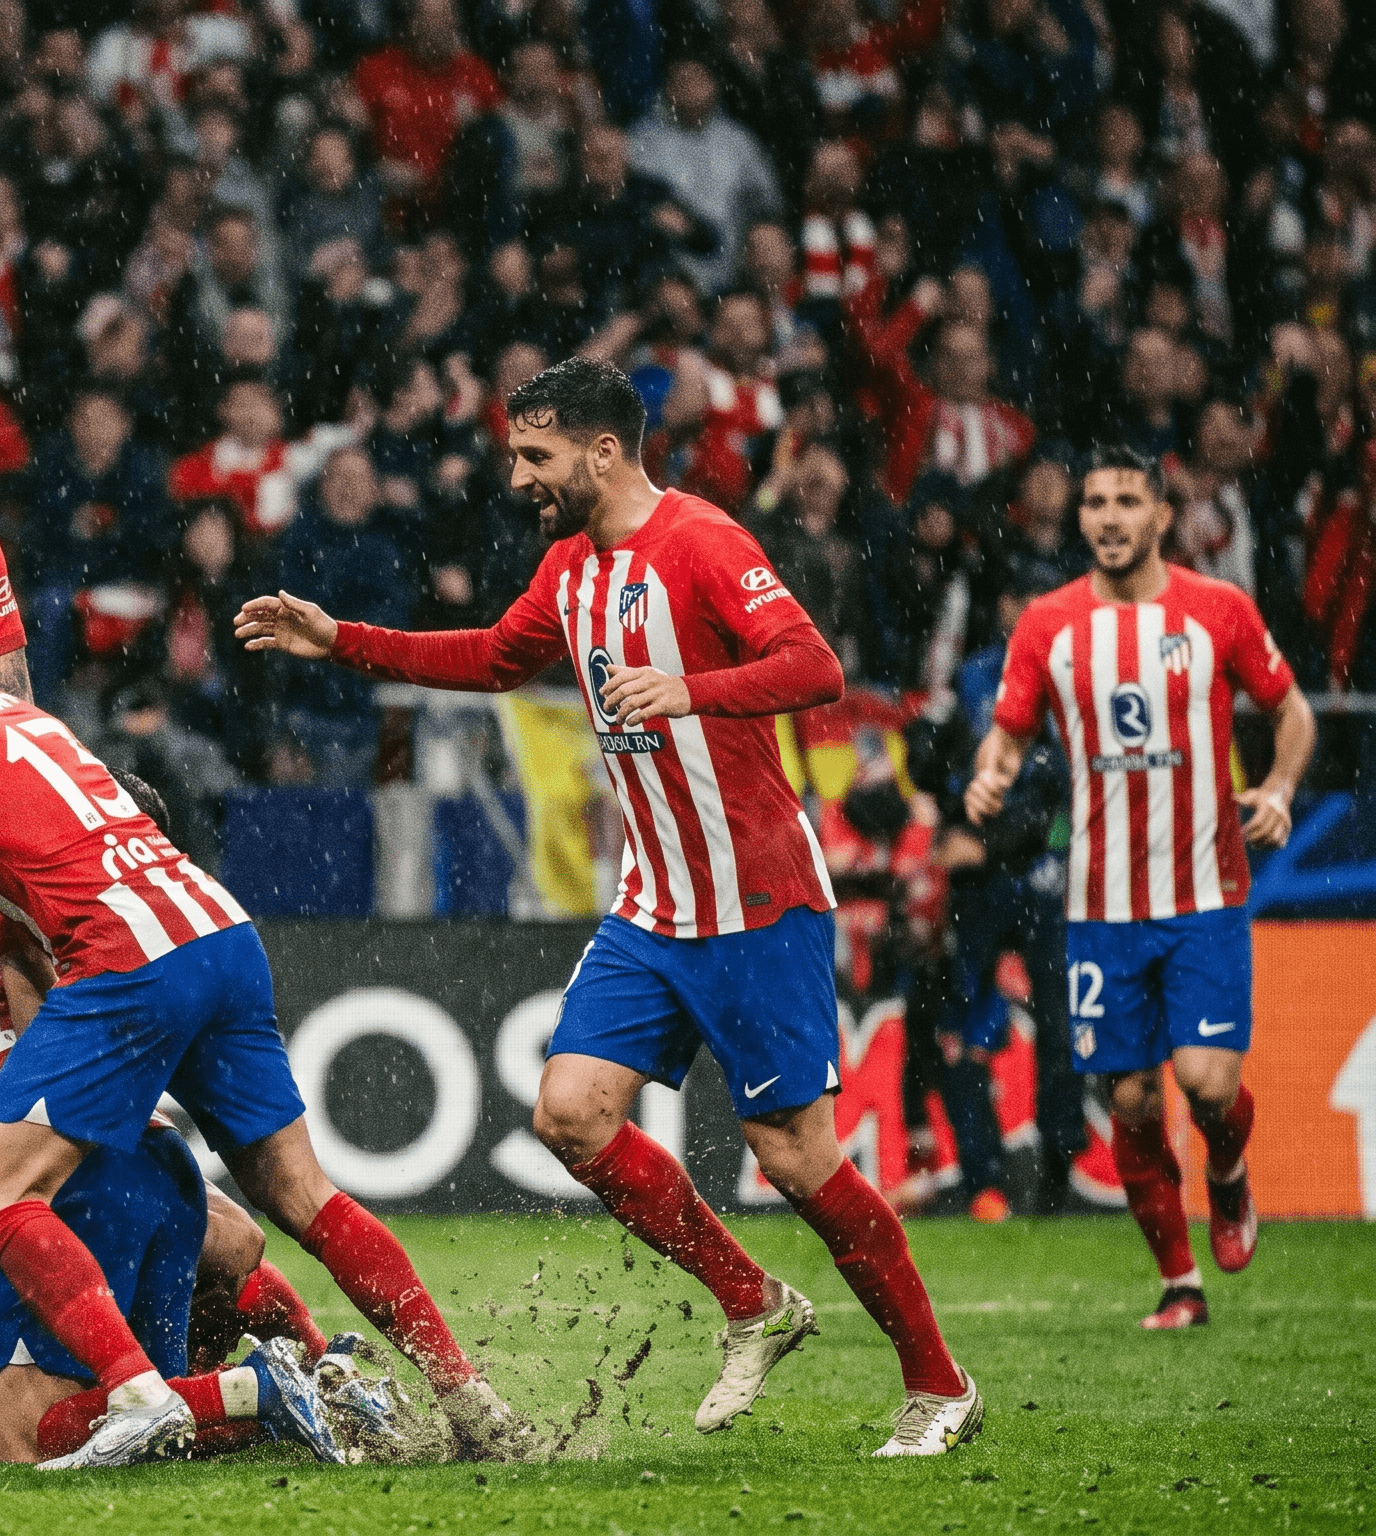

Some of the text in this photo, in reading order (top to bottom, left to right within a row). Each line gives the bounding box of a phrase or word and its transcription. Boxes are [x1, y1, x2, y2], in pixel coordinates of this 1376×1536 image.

[5, 718, 141, 831] 13
[102, 834, 159, 880] ria
[1067, 960, 1105, 1018] 12
